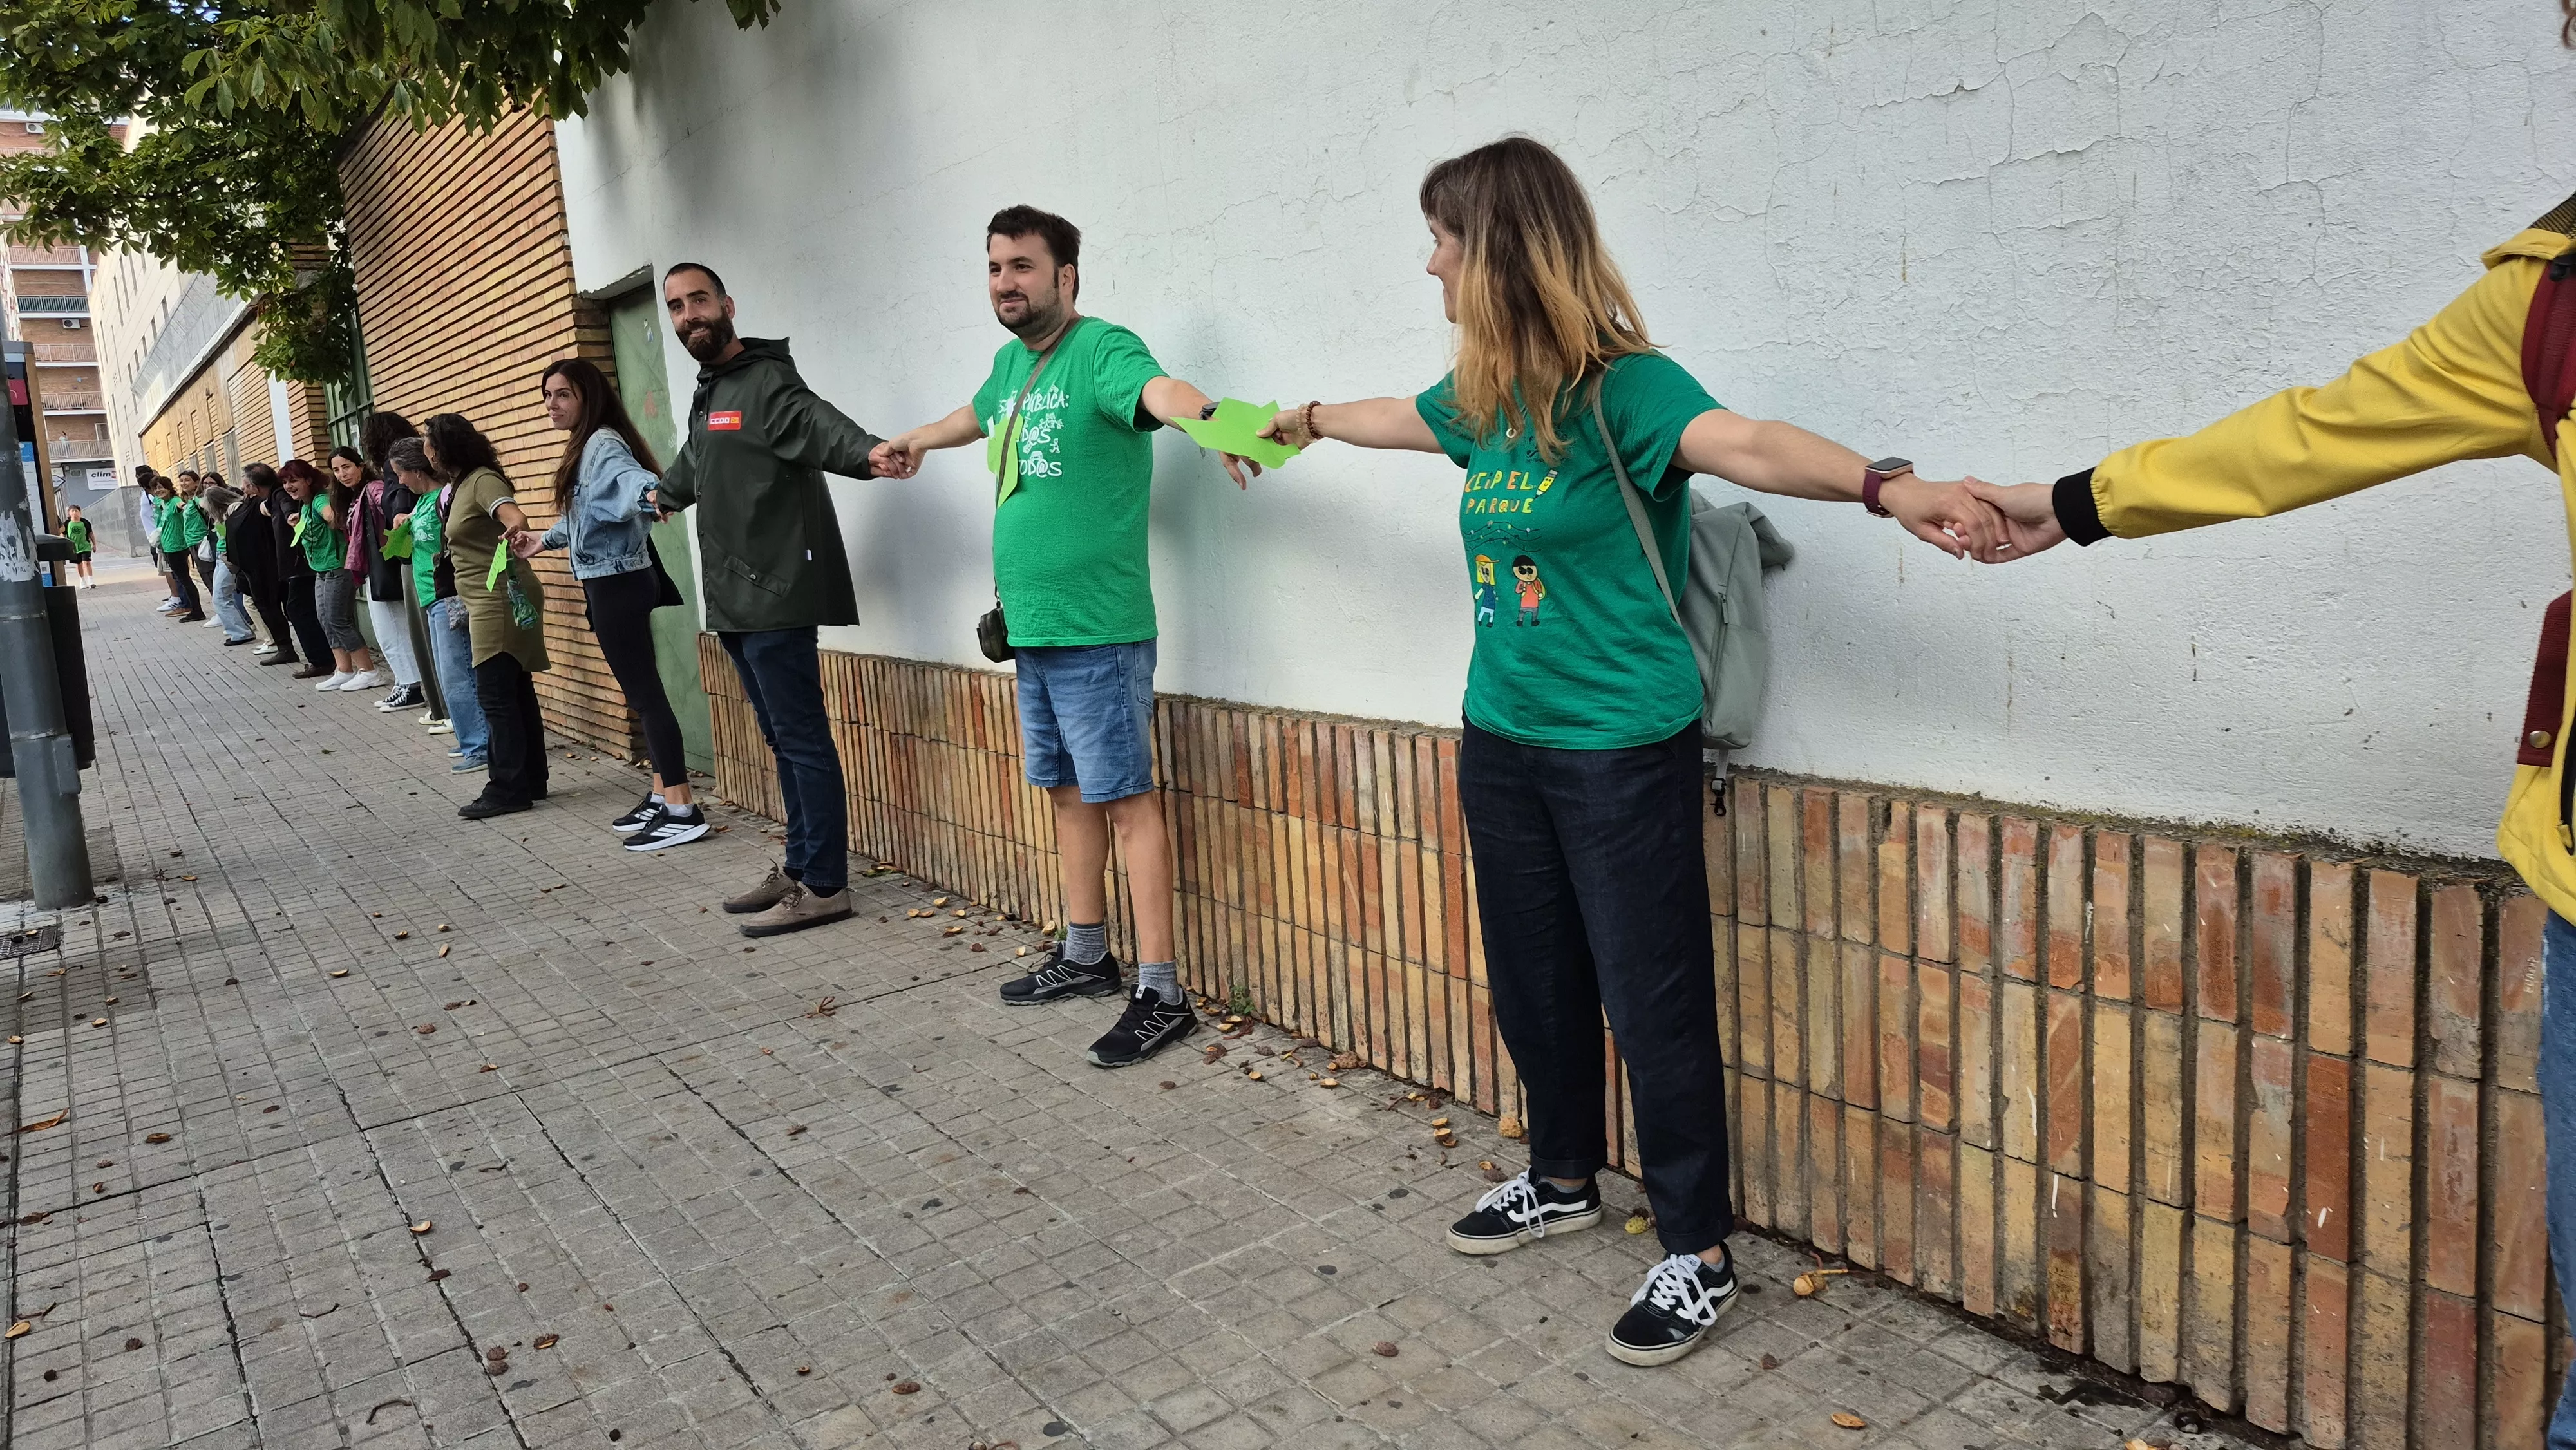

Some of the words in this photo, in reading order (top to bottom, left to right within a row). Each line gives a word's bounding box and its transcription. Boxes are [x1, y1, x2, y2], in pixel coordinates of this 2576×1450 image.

[1019, 458, 1063, 478] OD@S
[1506, 471, 1531, 491] EL
[1464, 498, 1534, 514] PARQUE
